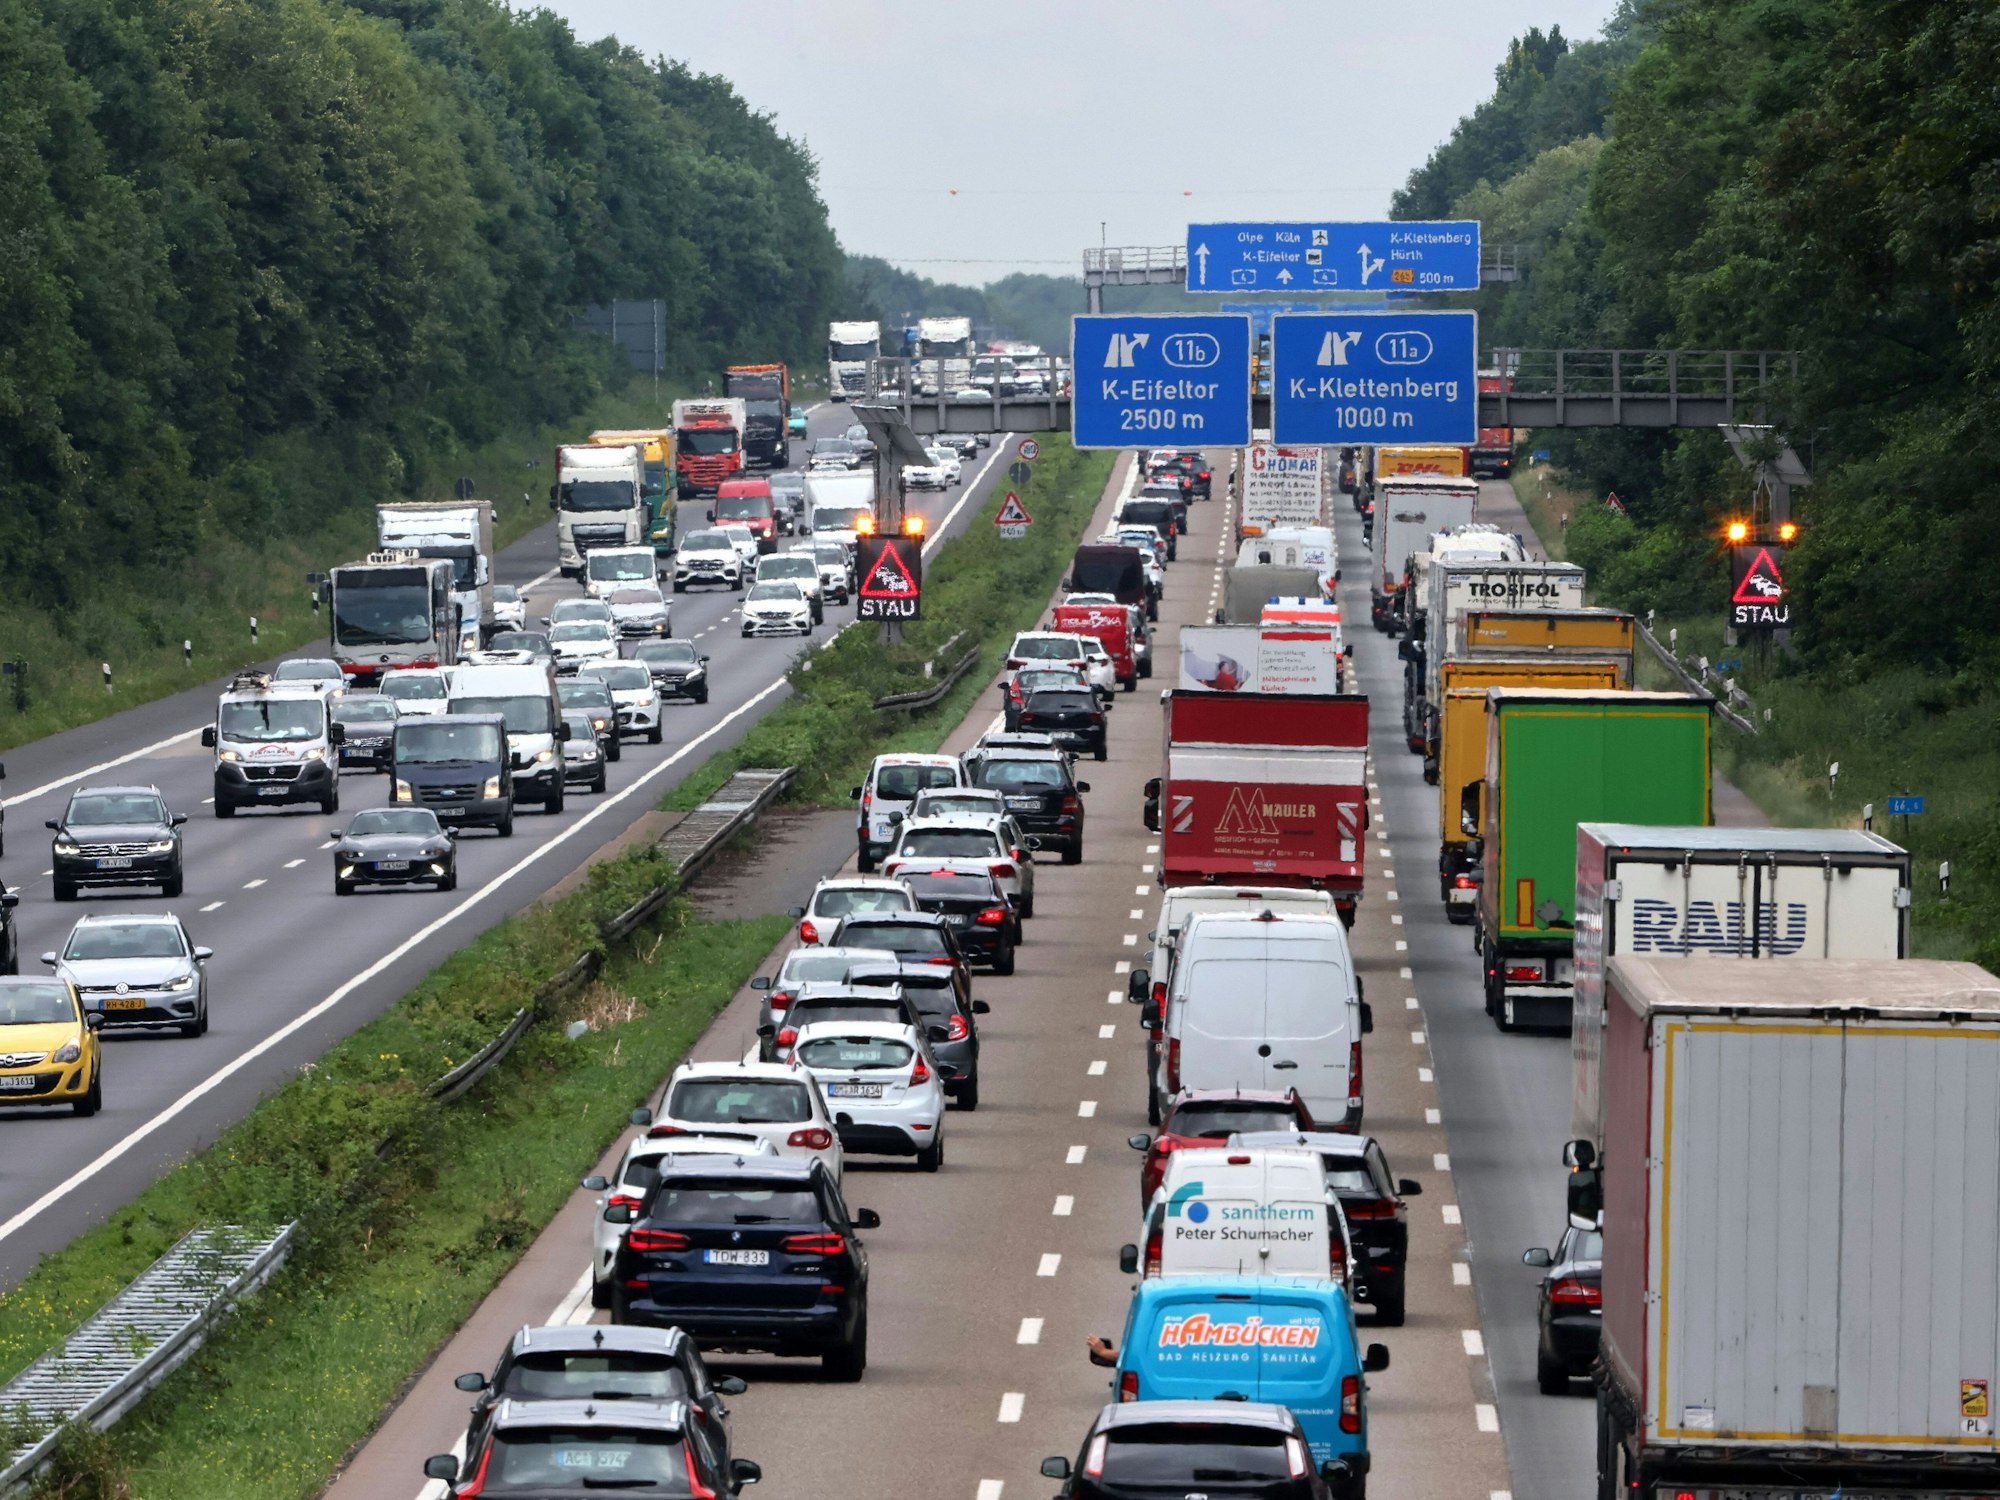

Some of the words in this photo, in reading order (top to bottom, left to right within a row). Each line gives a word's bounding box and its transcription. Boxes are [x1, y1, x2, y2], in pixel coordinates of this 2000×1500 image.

[1238, 232, 1264, 244] Olpe
[1275, 231, 1301, 242] Köln
[1390, 232, 1472, 246] K-Klettenberg
[1243, 250, 1300, 262] K-Eifeltor
[1391, 249, 1423, 260] Hürth
[1420, 273, 1441, 284] 500
[1443, 274, 1454, 284] m
[1175, 340, 1206, 362] 11b
[1389, 338, 1418, 358] 11a
[1102, 379, 1219, 401] K-Eifeltor
[1290, 377, 1458, 402] K-Klettenberg
[1121, 408, 1176, 430] 2500
[1182, 413, 1204, 429] m
[1335, 407, 1387, 429] 1000
[1392, 412, 1414, 427] m
[1469, 582, 1560, 598] TROSIFOL
[861, 599, 915, 616] STAU
[1735, 605, 1789, 623] STAU
[1221, 1204, 1314, 1221] sanitherm
[1176, 1226, 1216, 1240] Peter
[1221, 1226, 1314, 1242] Schumacher
[1159, 1313, 1321, 1349] HAMBÜCKEN
[1159, 1353, 1182, 1361] BAD
[1192, 1352, 1250, 1362] HEIZUNG
[1967, 1419, 1980, 1432] PL
